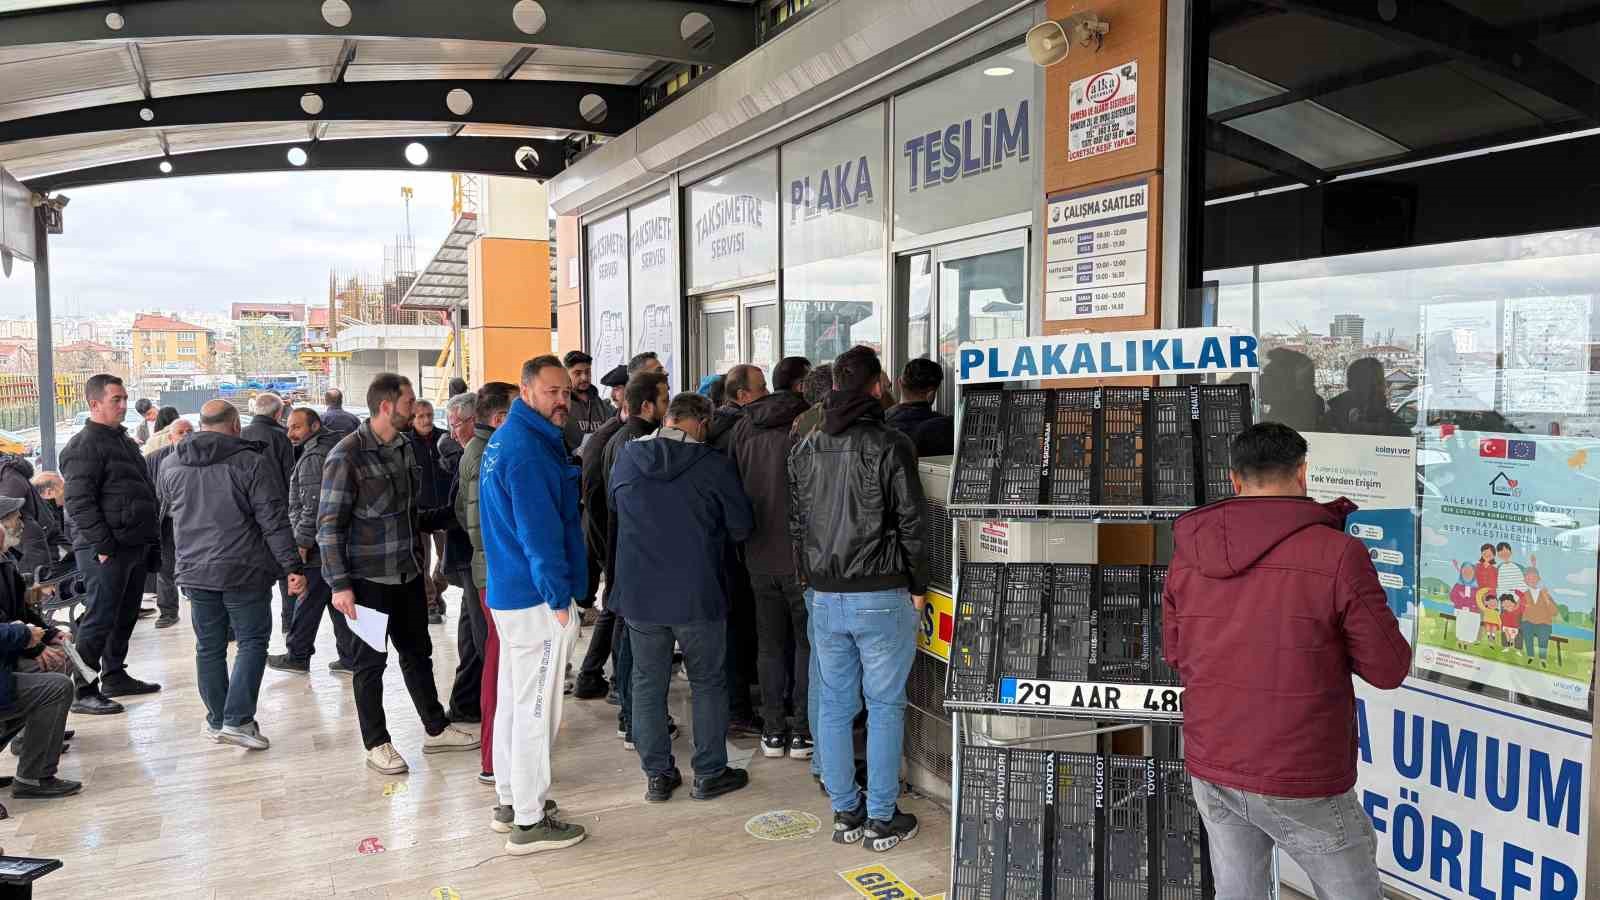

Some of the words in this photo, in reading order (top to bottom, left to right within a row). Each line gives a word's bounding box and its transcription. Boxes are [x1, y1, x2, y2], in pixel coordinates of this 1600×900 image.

[904, 100, 1029, 191] TESLİM
[791, 156, 874, 223] PLAKA
[1064, 202, 1100, 221] ÇALIŞMA
[1102, 188, 1145, 212] SAATLERİ
[695, 195, 763, 243] TAKSİMETRE
[960, 335, 1259, 380] PLAKALIKLAR
[1192, 385, 1200, 420] RENAULT
[1311, 474, 1324, 482] Tek
[1325, 475, 1354, 485] Yerden
[1356, 478, 1381, 489] Erişim
[1018, 683, 1051, 705] 29
[1071, 685, 1121, 709] AAR
[1143, 688, 1184, 712] 48
[997, 753, 1006, 802] HYUNDAI
[1046, 751, 1055, 805] HONDA
[1095, 755, 1104, 808] PEUGEOT
[1147, 758, 1156, 796] TOYOTA
[1393, 709, 1583, 835] UMUM
